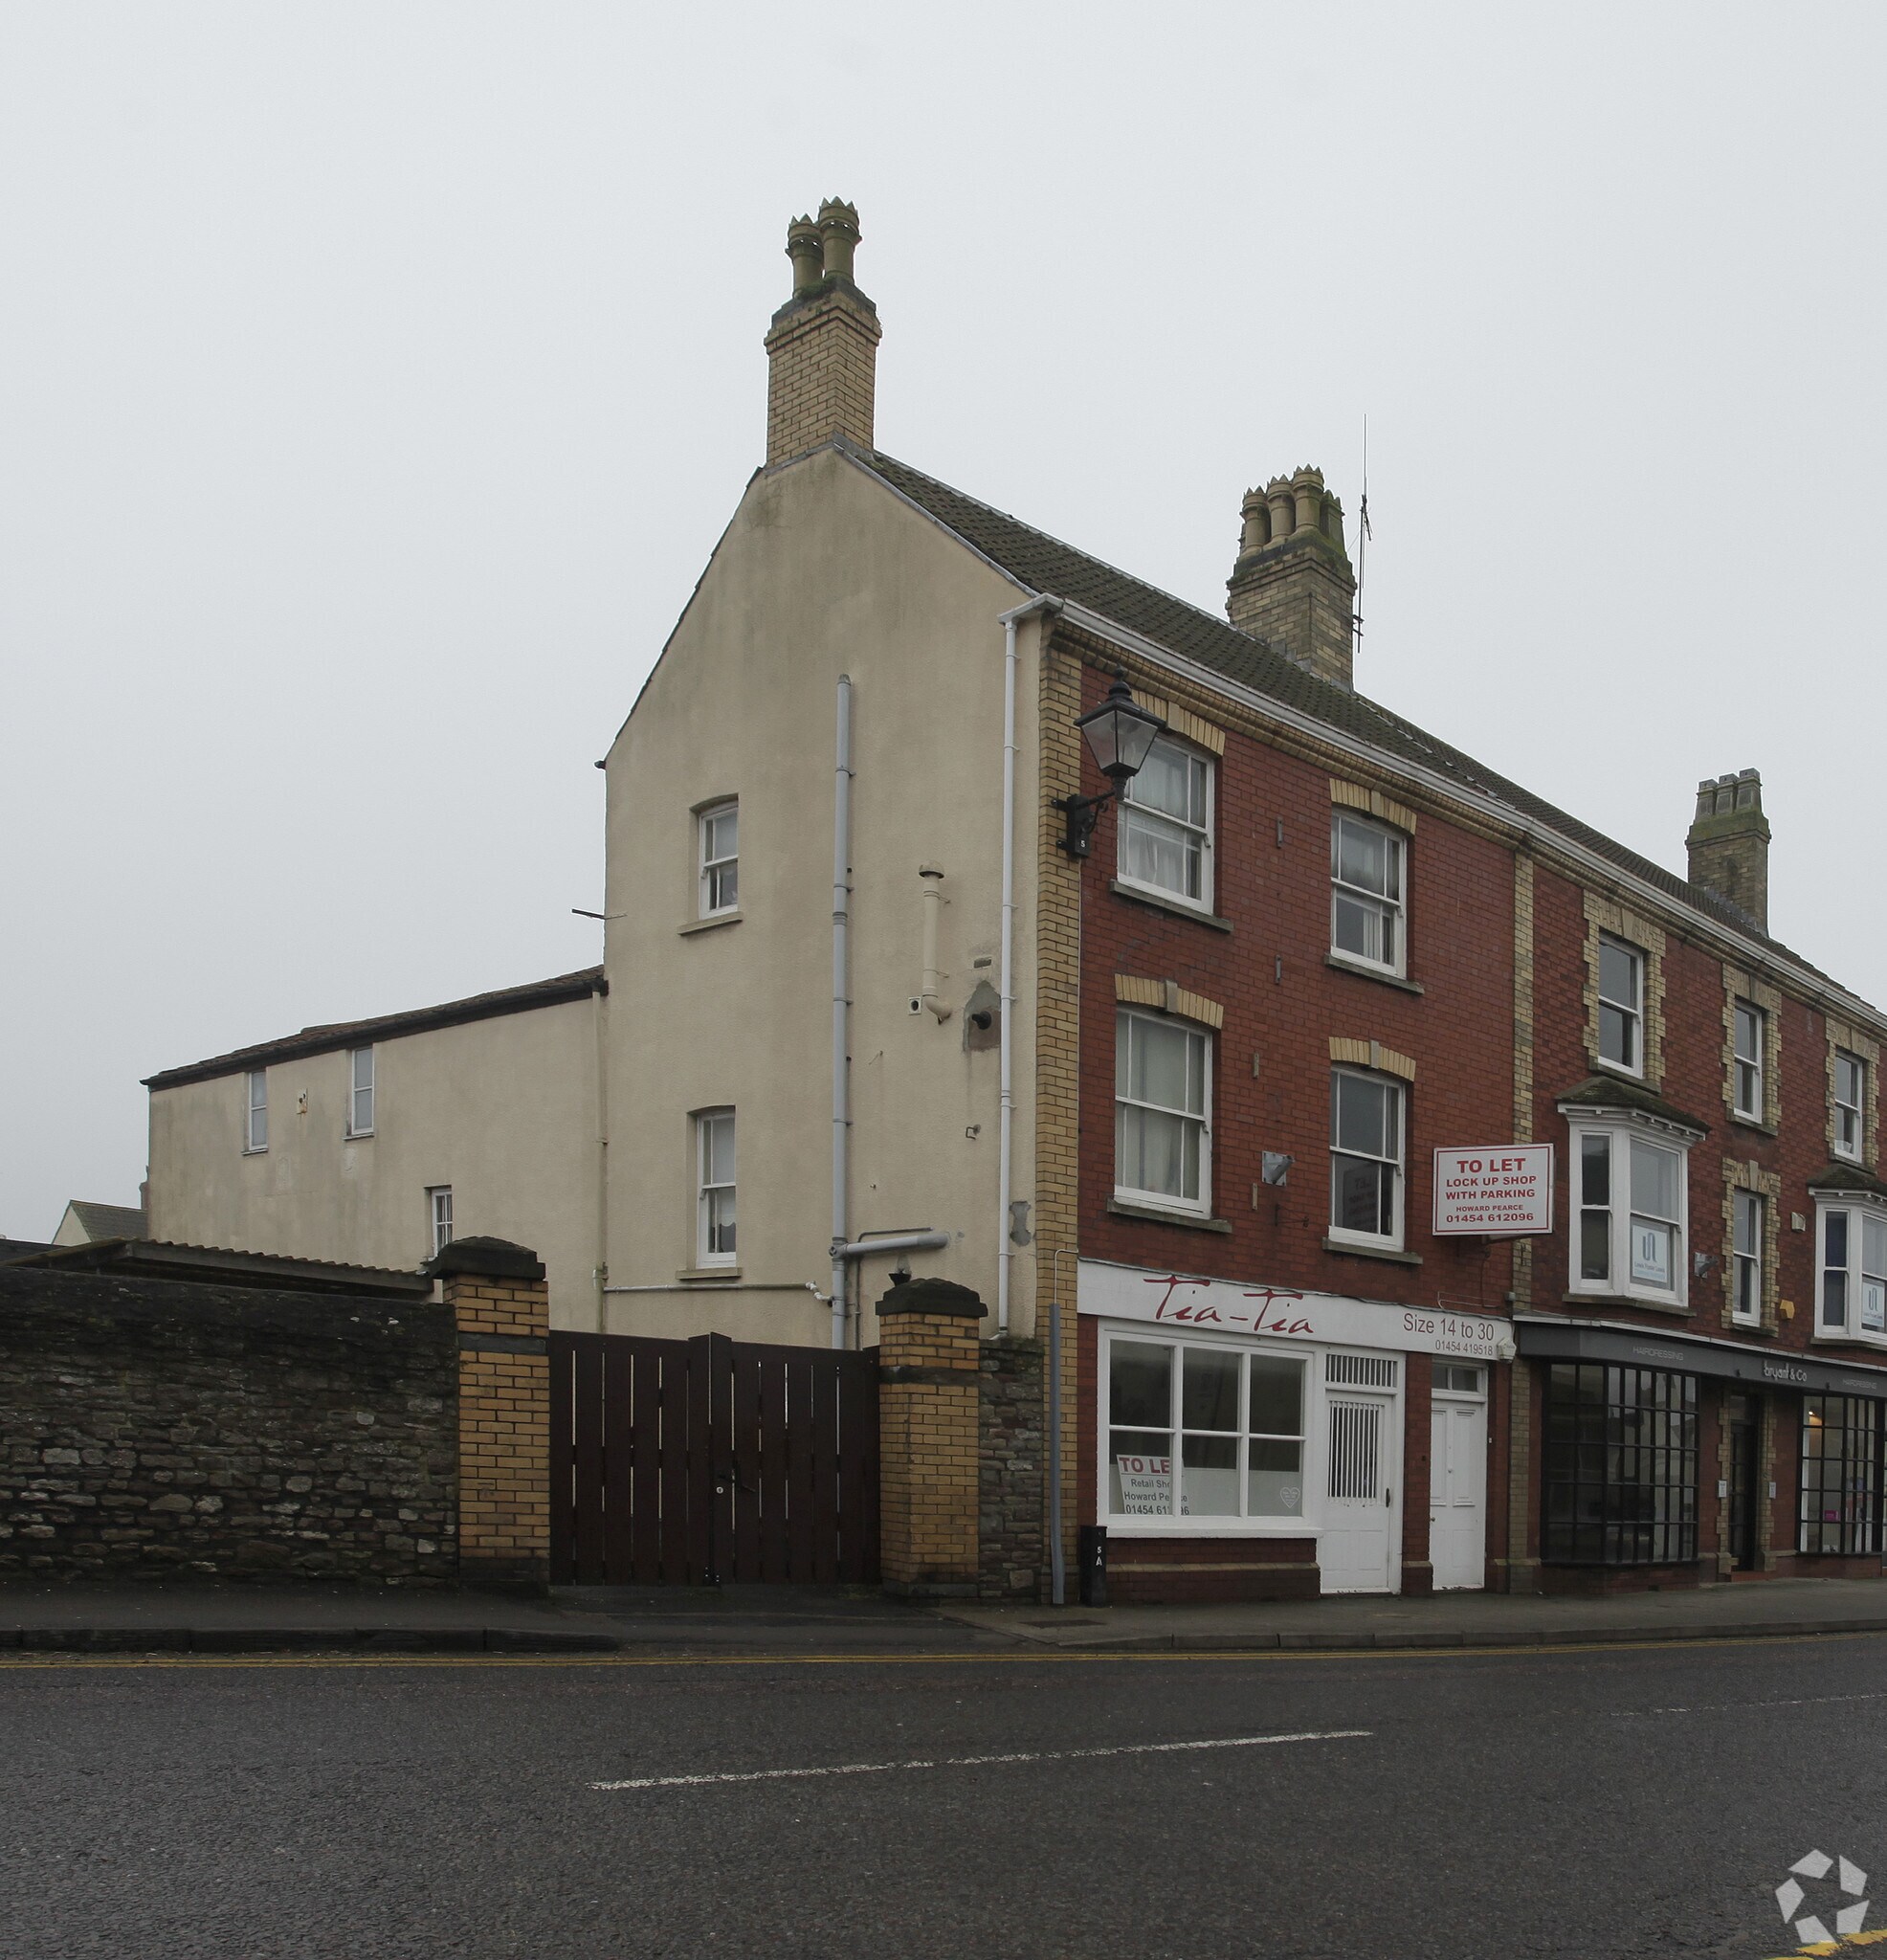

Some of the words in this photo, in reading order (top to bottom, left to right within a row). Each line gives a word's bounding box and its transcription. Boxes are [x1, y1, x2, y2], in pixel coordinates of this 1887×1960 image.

[1456, 1160, 1482, 1173] TO
[1489, 1158, 1526, 1172] LET
[1446, 1178, 1478, 1187] LOCK
[1482, 1177, 1499, 1186] UP
[1502, 1176, 1537, 1186] SHOP
[1446, 1192, 1476, 1200] WITH
[1480, 1190, 1535, 1199] PARKING
[1446, 1214, 1484, 1223] 01454
[1488, 1214, 1534, 1222] 612096
[1403, 1313, 1434, 1334] Size
[1440, 1318, 1455, 1336] 14
[1461, 1322, 1474, 1339] to
[1477, 1324, 1494, 1341] 30
[1435, 1340, 1461, 1352] 01454
[1463, 1344, 1493, 1356] 419518
[1119, 1458, 1144, 1473] TO
[1149, 1459, 1170, 1474] LE
[1131, 1479, 1154, 1488] Retail
[1124, 1492, 1157, 1502] Howard
[1125, 1504, 1154, 1515] 01454
